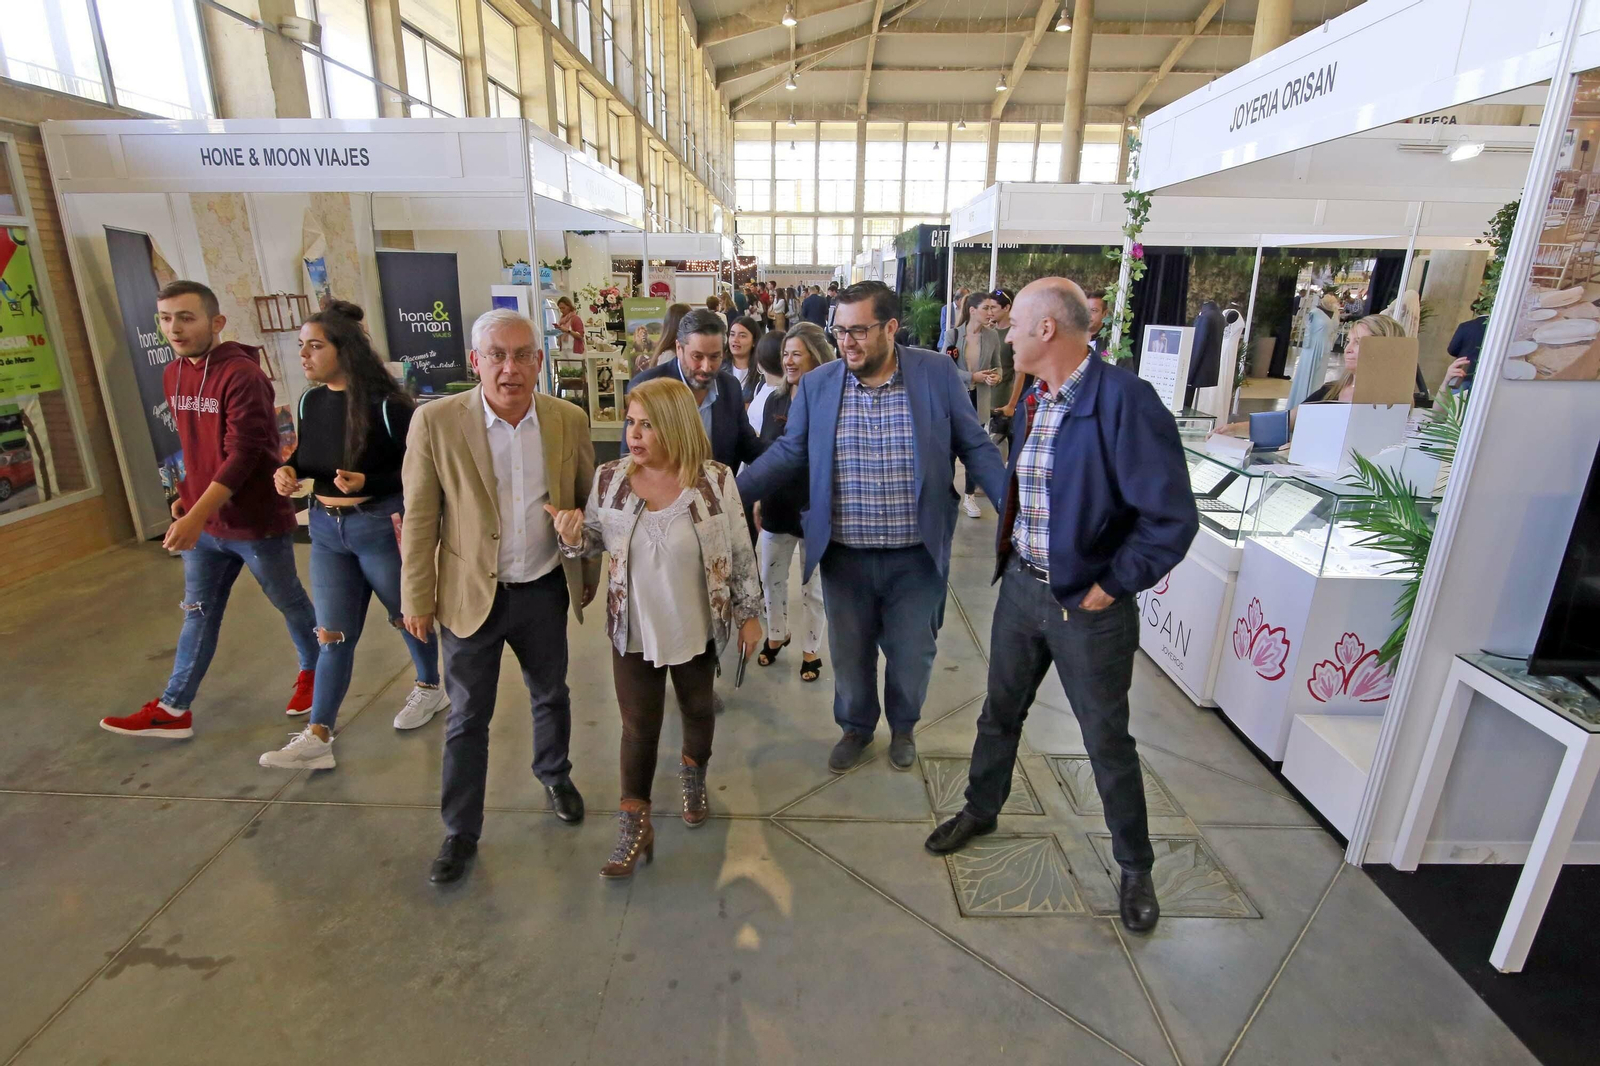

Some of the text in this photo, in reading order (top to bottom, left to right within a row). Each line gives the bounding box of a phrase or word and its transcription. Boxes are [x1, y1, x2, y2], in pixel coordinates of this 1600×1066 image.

[1229, 61, 1338, 133] JOYERIA ORISAN
[200, 147, 370, 167] HONE & MOON VIAJES
[411, 321, 452, 333] moon
[5, 357, 14, 365] de
[14, 356, 36, 364] Marzo
[147, 345, 174, 366] moon
